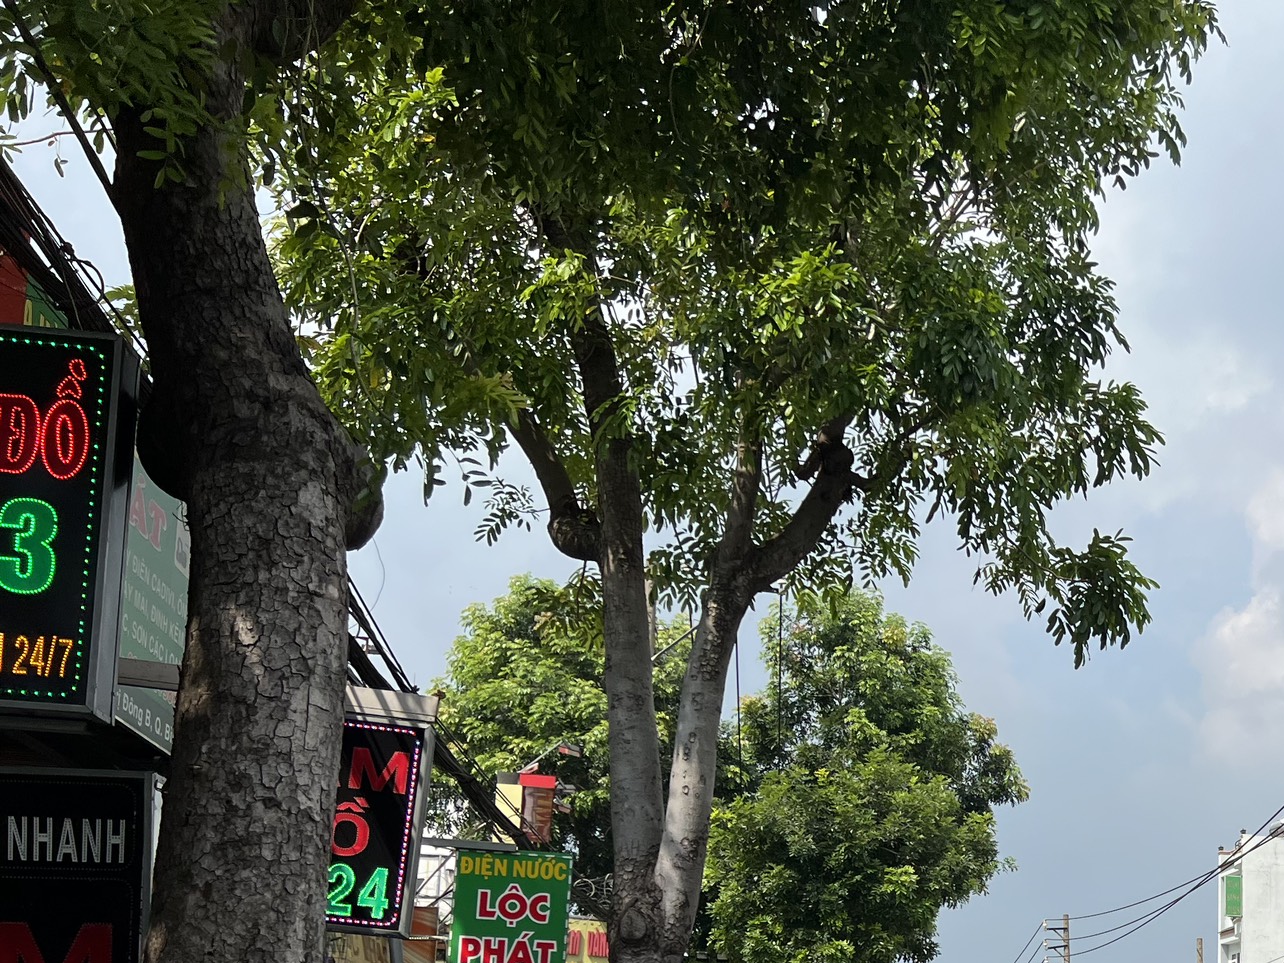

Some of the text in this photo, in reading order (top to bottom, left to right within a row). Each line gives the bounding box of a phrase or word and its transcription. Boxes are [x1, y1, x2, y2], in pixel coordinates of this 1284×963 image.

[12, 634, 73, 678] 24/7
[7, 815, 126, 864] NHANH
[459, 853, 568, 882] ĐIỆN NƯỚC
[326, 863, 389, 920] 24
[476, 883, 550, 927] LỘC
